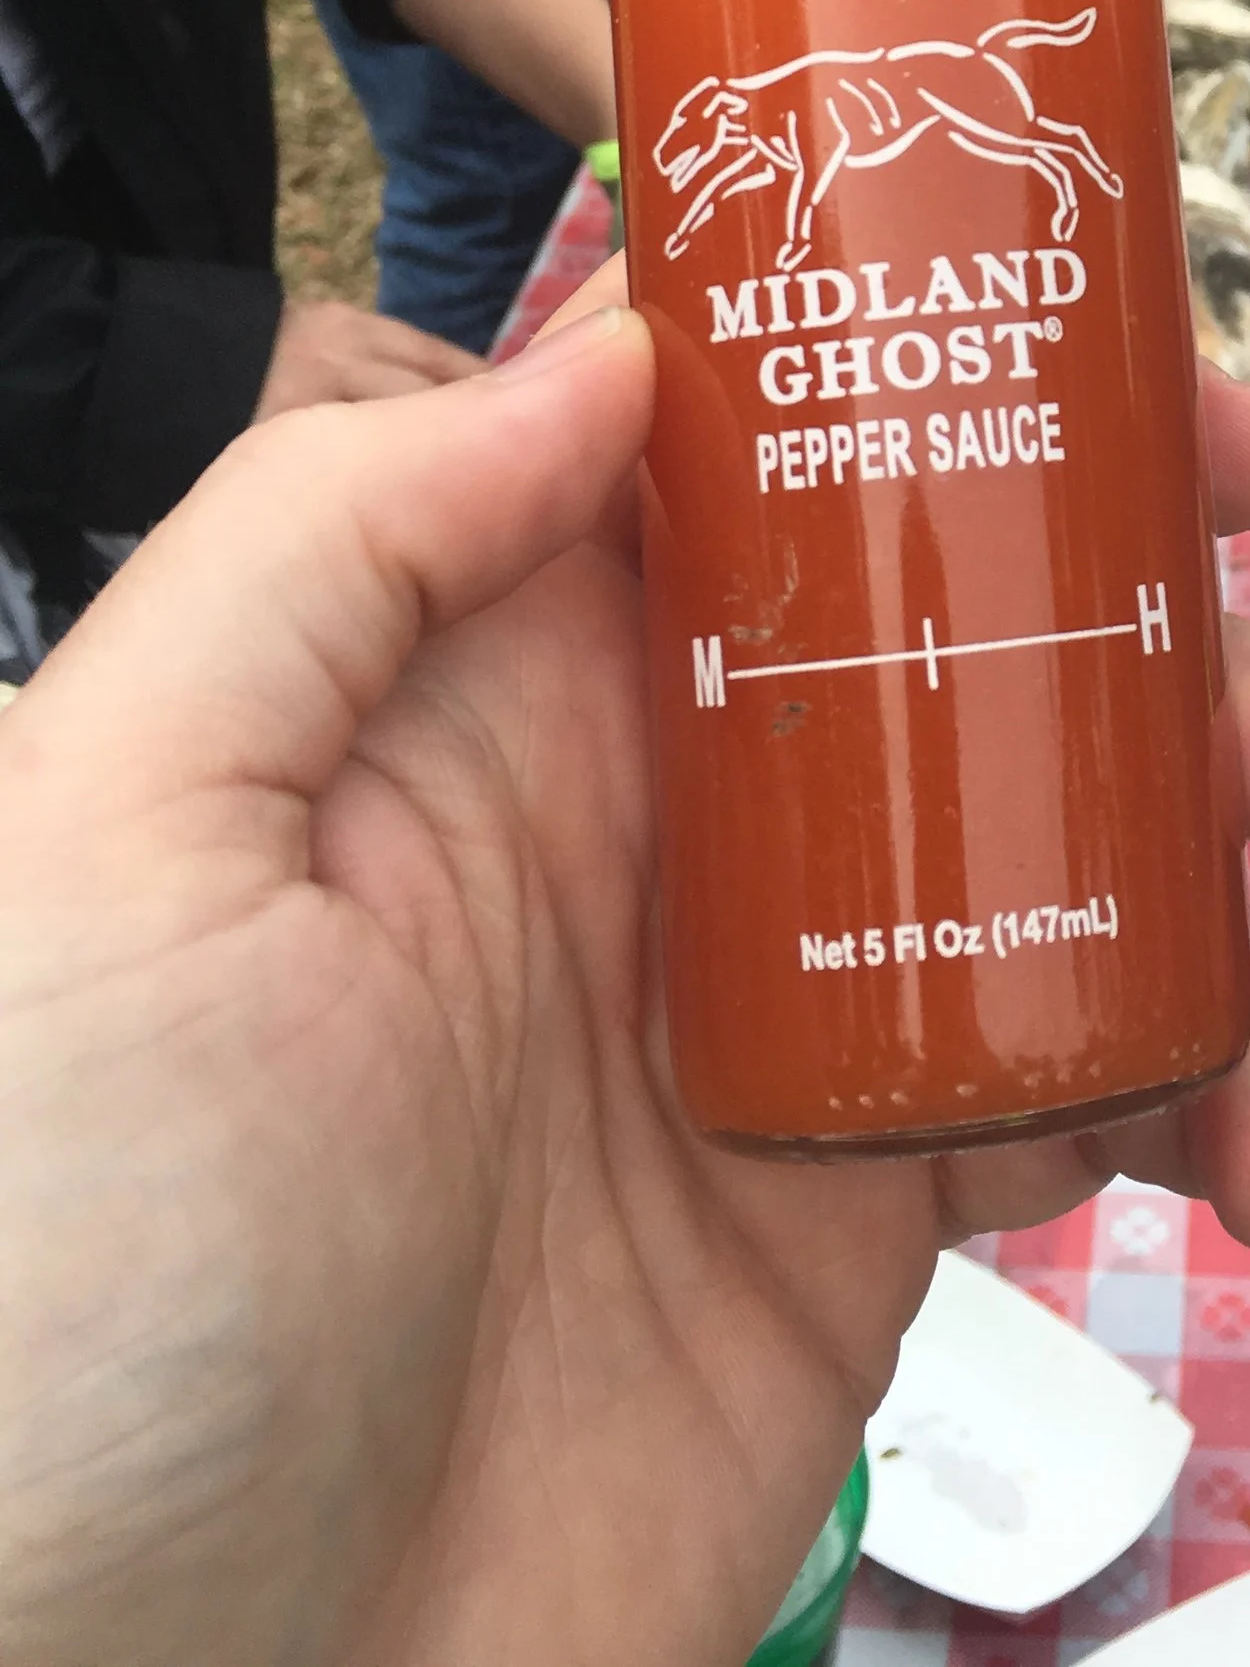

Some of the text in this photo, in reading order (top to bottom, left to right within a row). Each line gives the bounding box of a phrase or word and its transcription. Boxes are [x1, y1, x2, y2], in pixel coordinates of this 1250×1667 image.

[706, 248, 1088, 343] MIDLAND
[756, 402, 1066, 494] PEPPER SAUCE
[692, 582, 1172, 708] M H
[799, 932, 858, 972] Net
[863, 928, 886, 967] 5
[933, 919, 986, 959] Oz
[991, 894, 1119, 959] (147mL)
